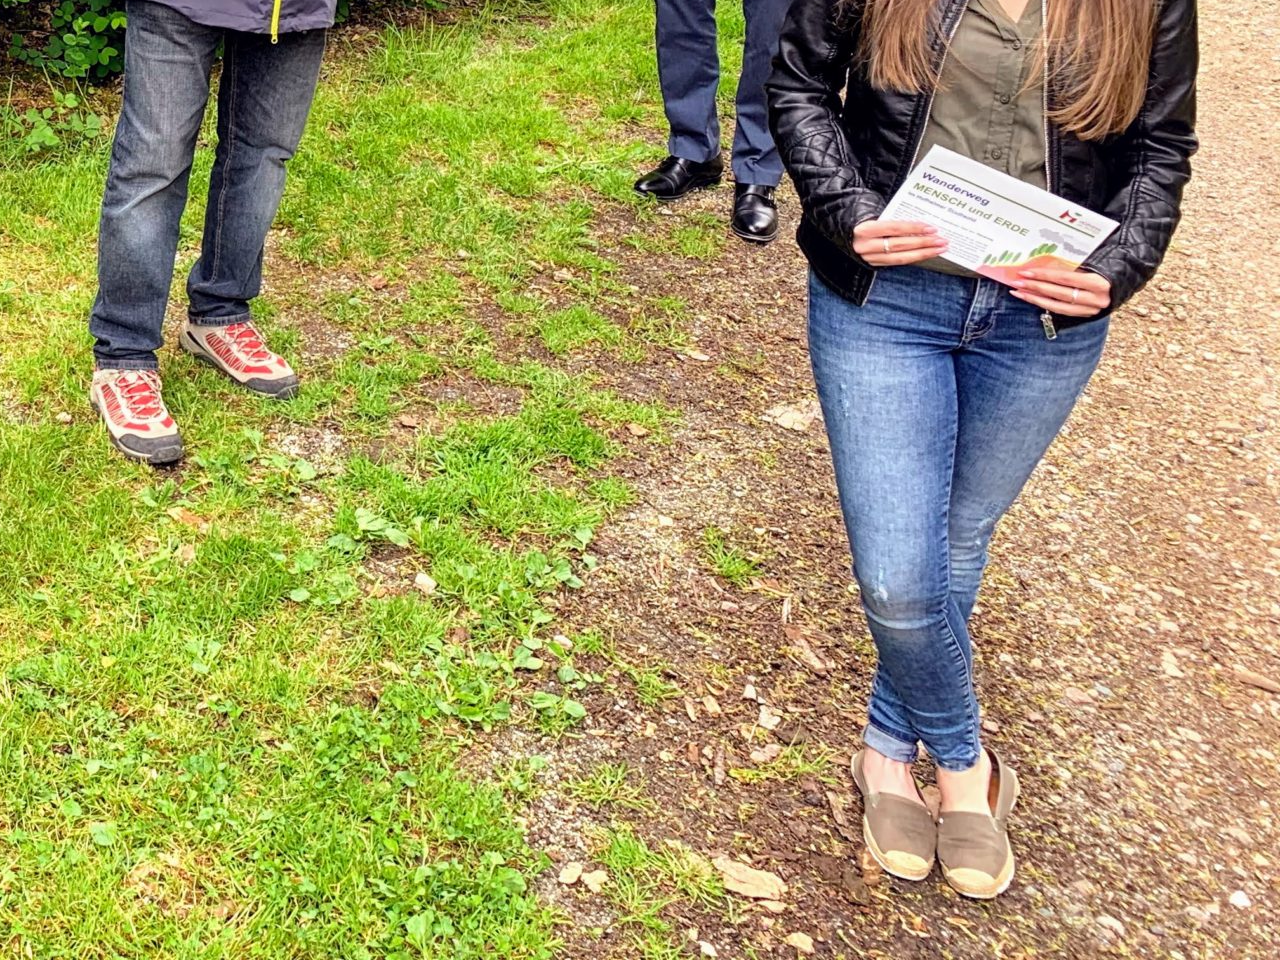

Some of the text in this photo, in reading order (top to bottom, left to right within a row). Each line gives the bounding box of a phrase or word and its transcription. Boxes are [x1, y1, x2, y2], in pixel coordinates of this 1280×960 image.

[913, 182, 1030, 237] MENSCH und ERDE
[922, 171, 990, 207] Wanderweg
